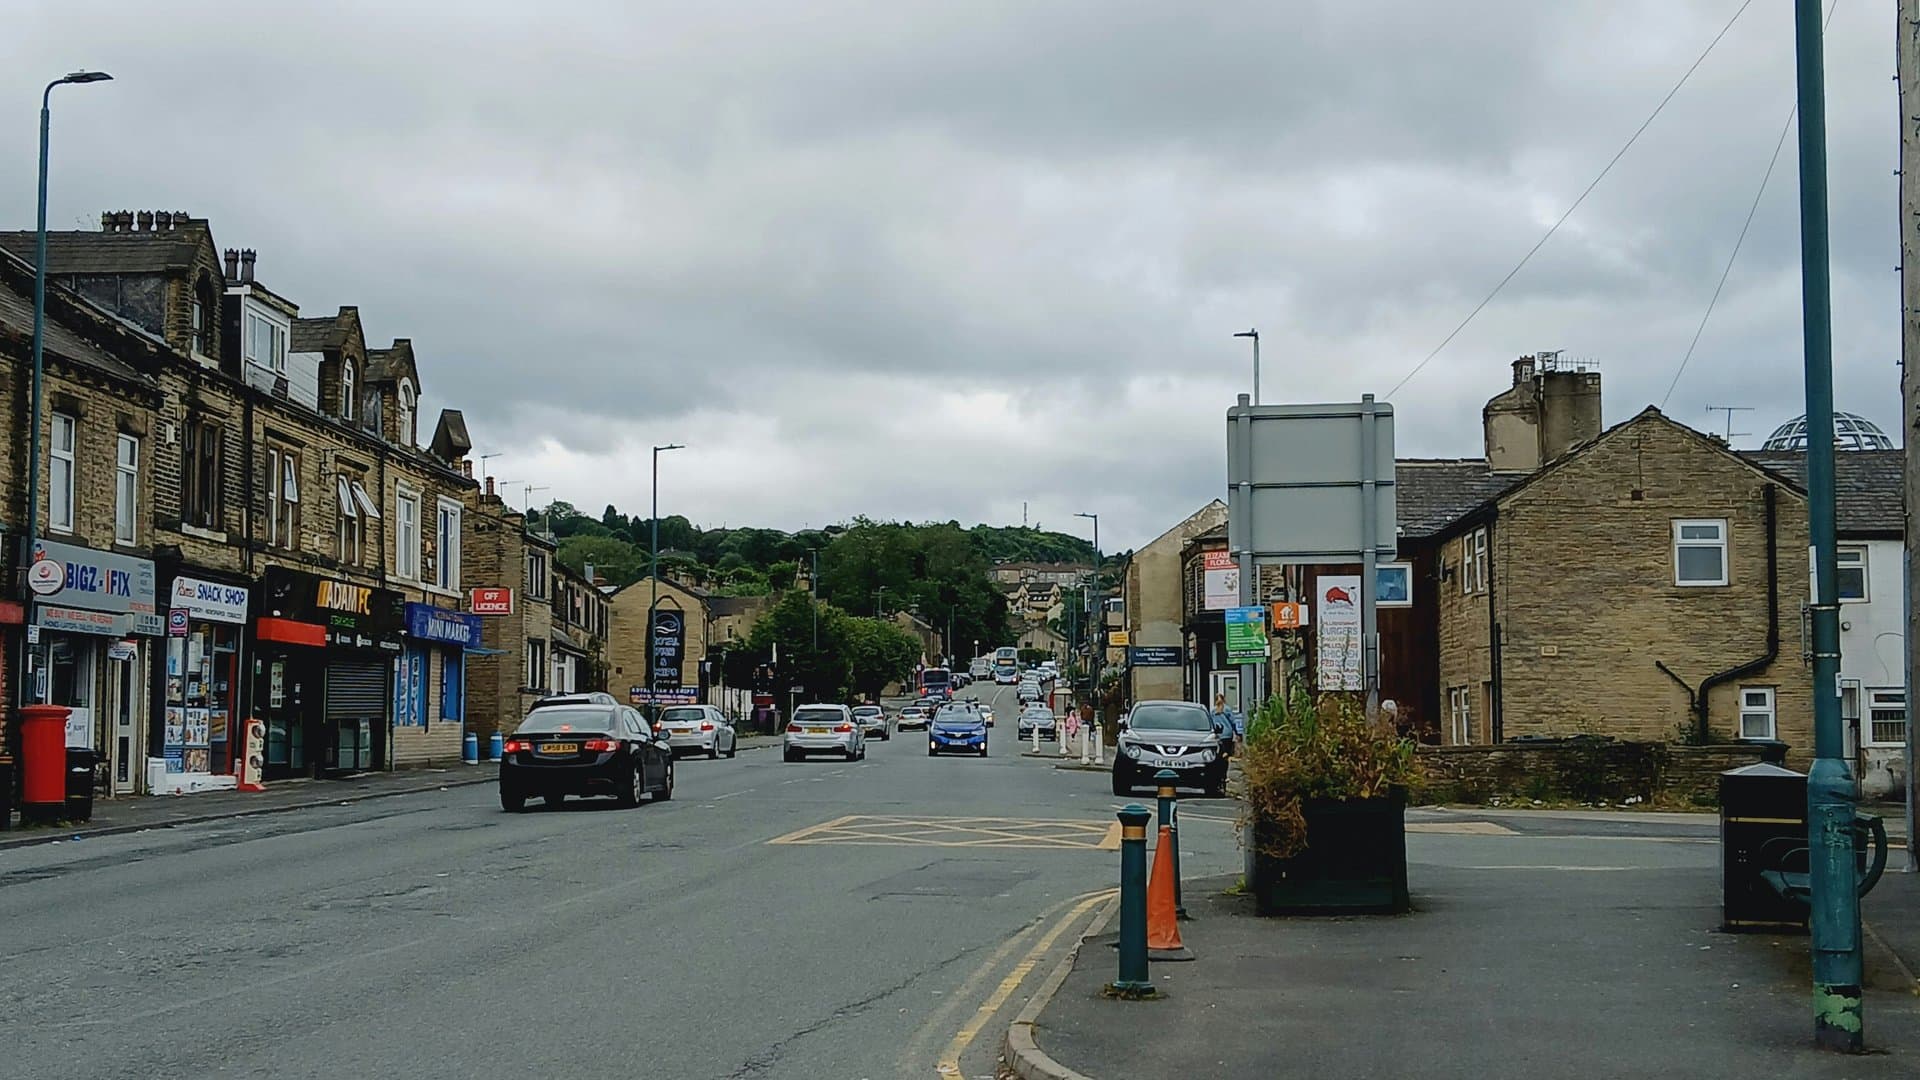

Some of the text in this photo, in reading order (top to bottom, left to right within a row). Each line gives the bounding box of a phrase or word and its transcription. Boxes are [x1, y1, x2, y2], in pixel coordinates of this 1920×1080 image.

[66, 562, 98, 593] BIGZ
[197, 583, 224, 605] SNACK
[225, 588, 245, 608] SHOP
[325, 580, 358, 614] ADAM
[357, 586, 372, 616] FC
[475, 602, 508, 611] LICENCE
[483, 592, 500, 601] OFF
[427, 617, 471, 643] MINI MARKET
